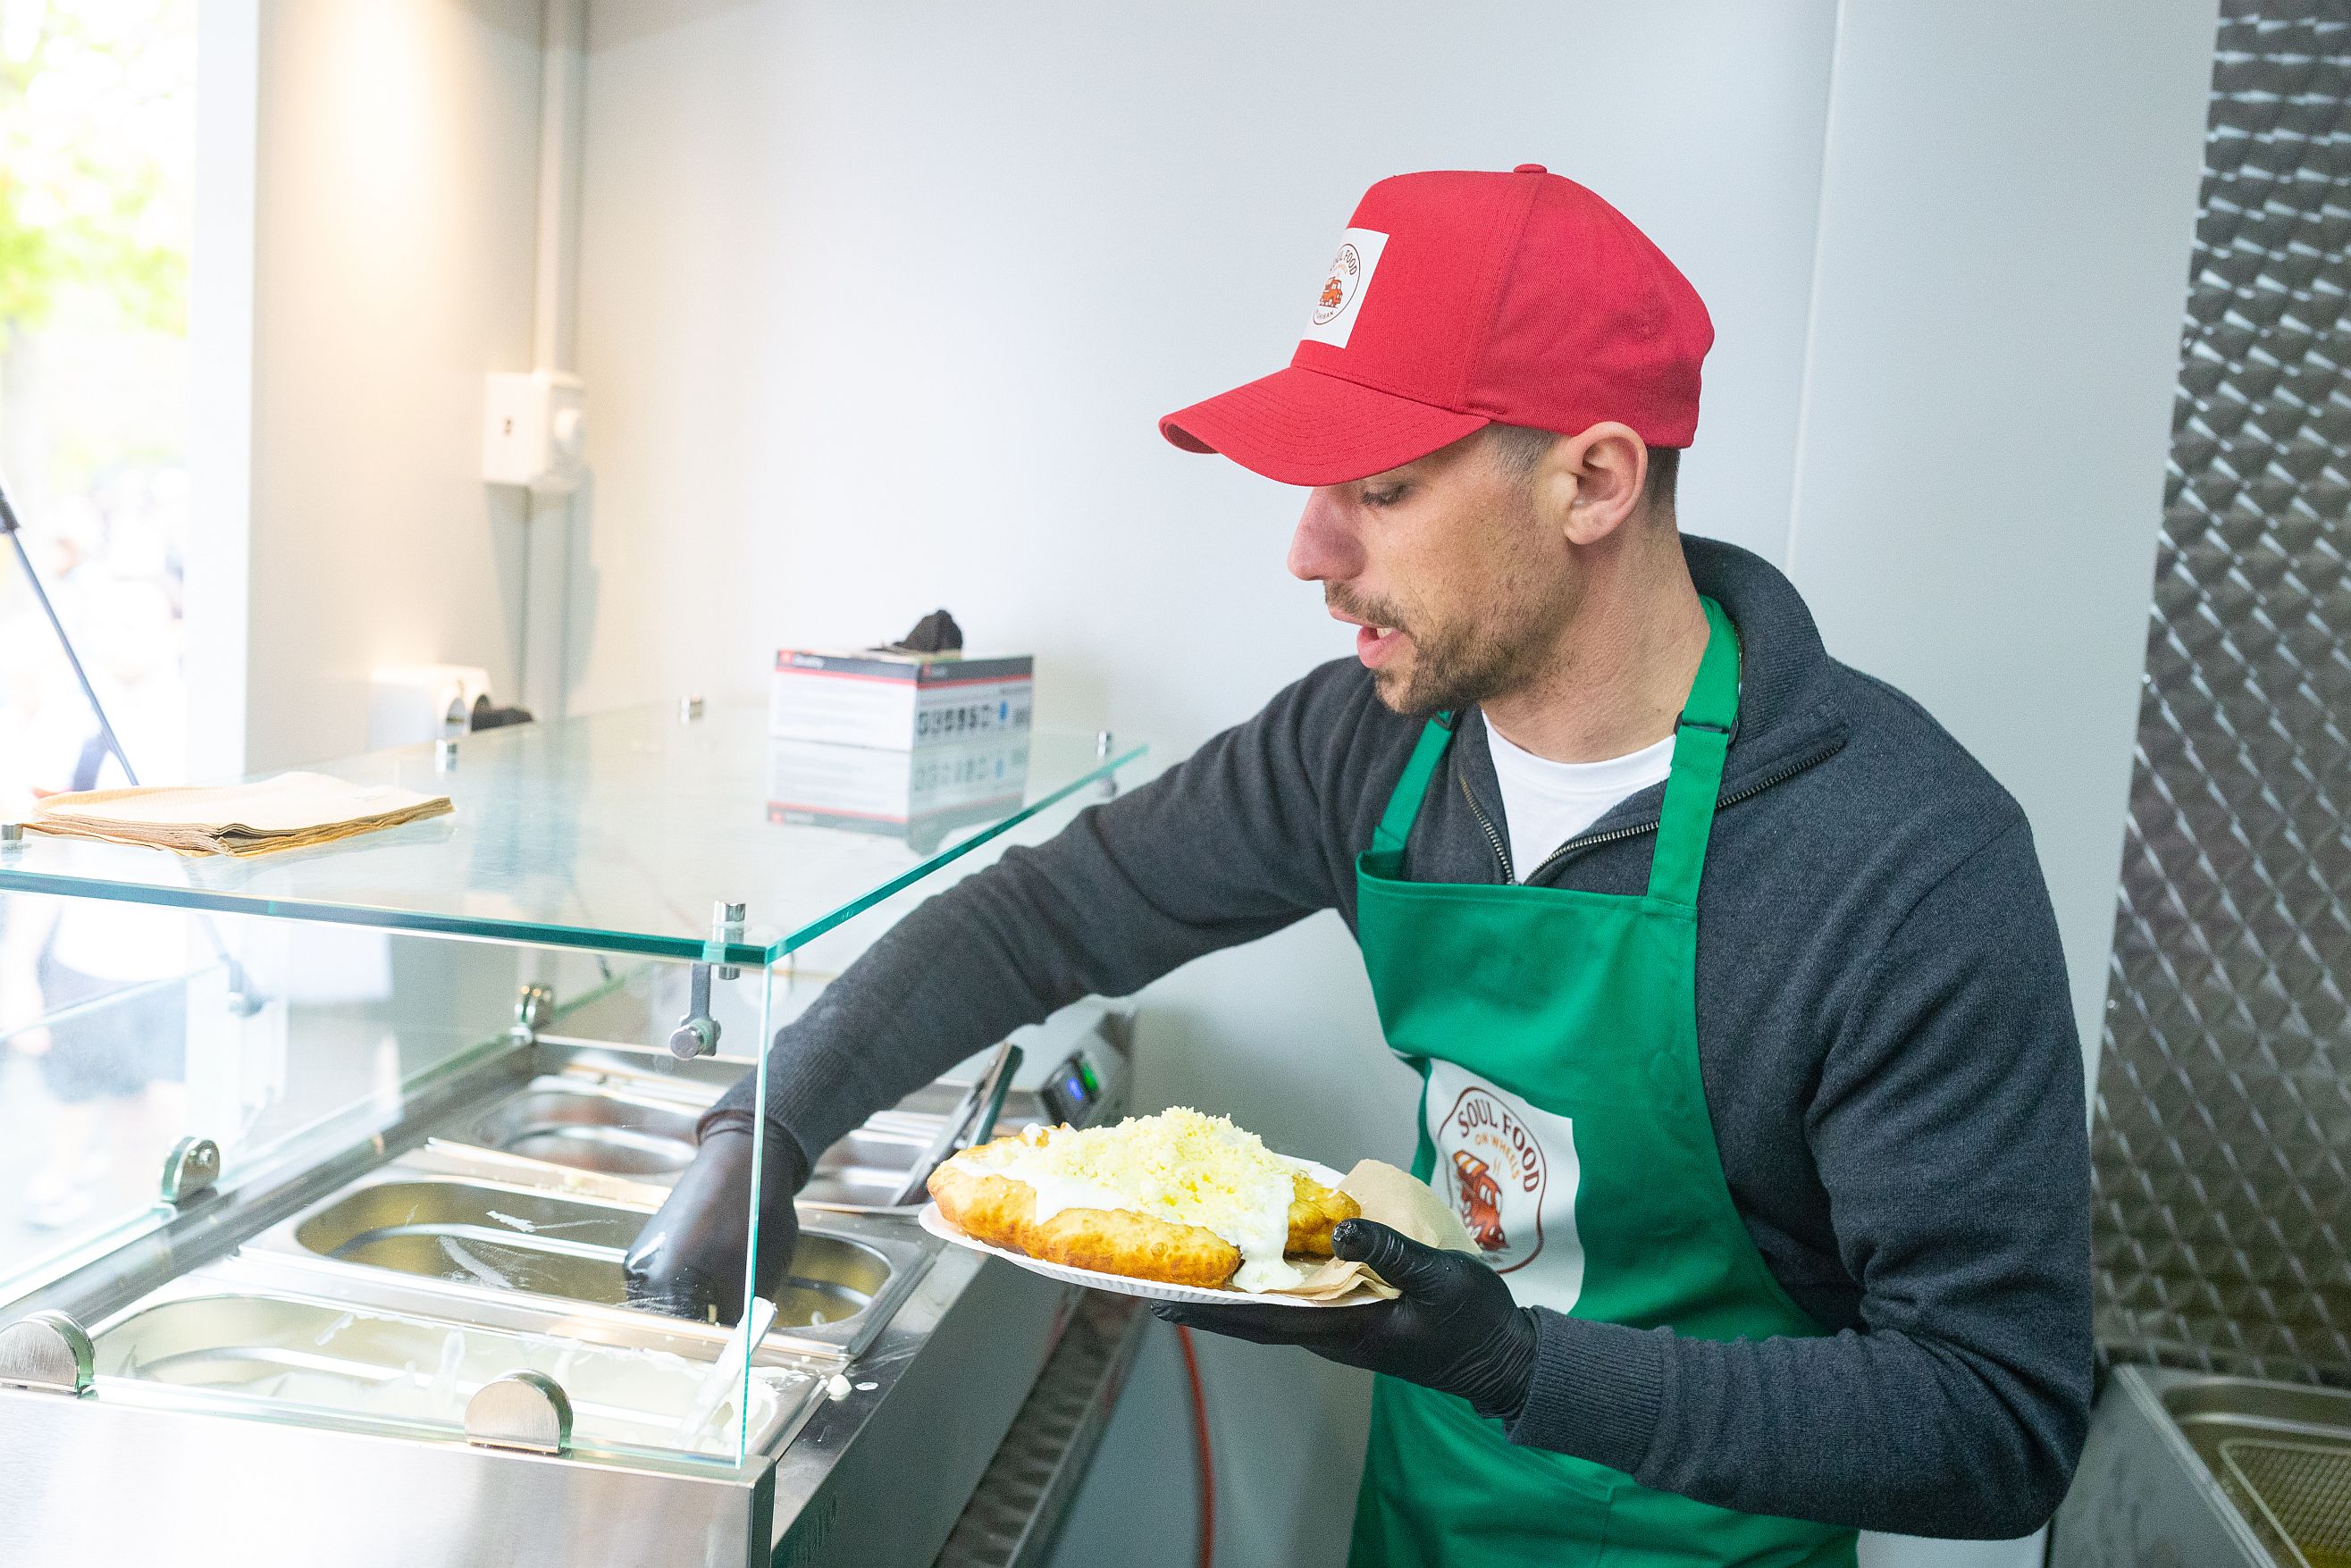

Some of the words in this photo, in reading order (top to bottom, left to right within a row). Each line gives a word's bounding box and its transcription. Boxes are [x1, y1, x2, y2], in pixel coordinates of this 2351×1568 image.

[1344, 249, 1357, 275] FOOD
[1458, 1099, 1498, 1137] SOUL
[1503, 1113, 1540, 1193] FOOD
